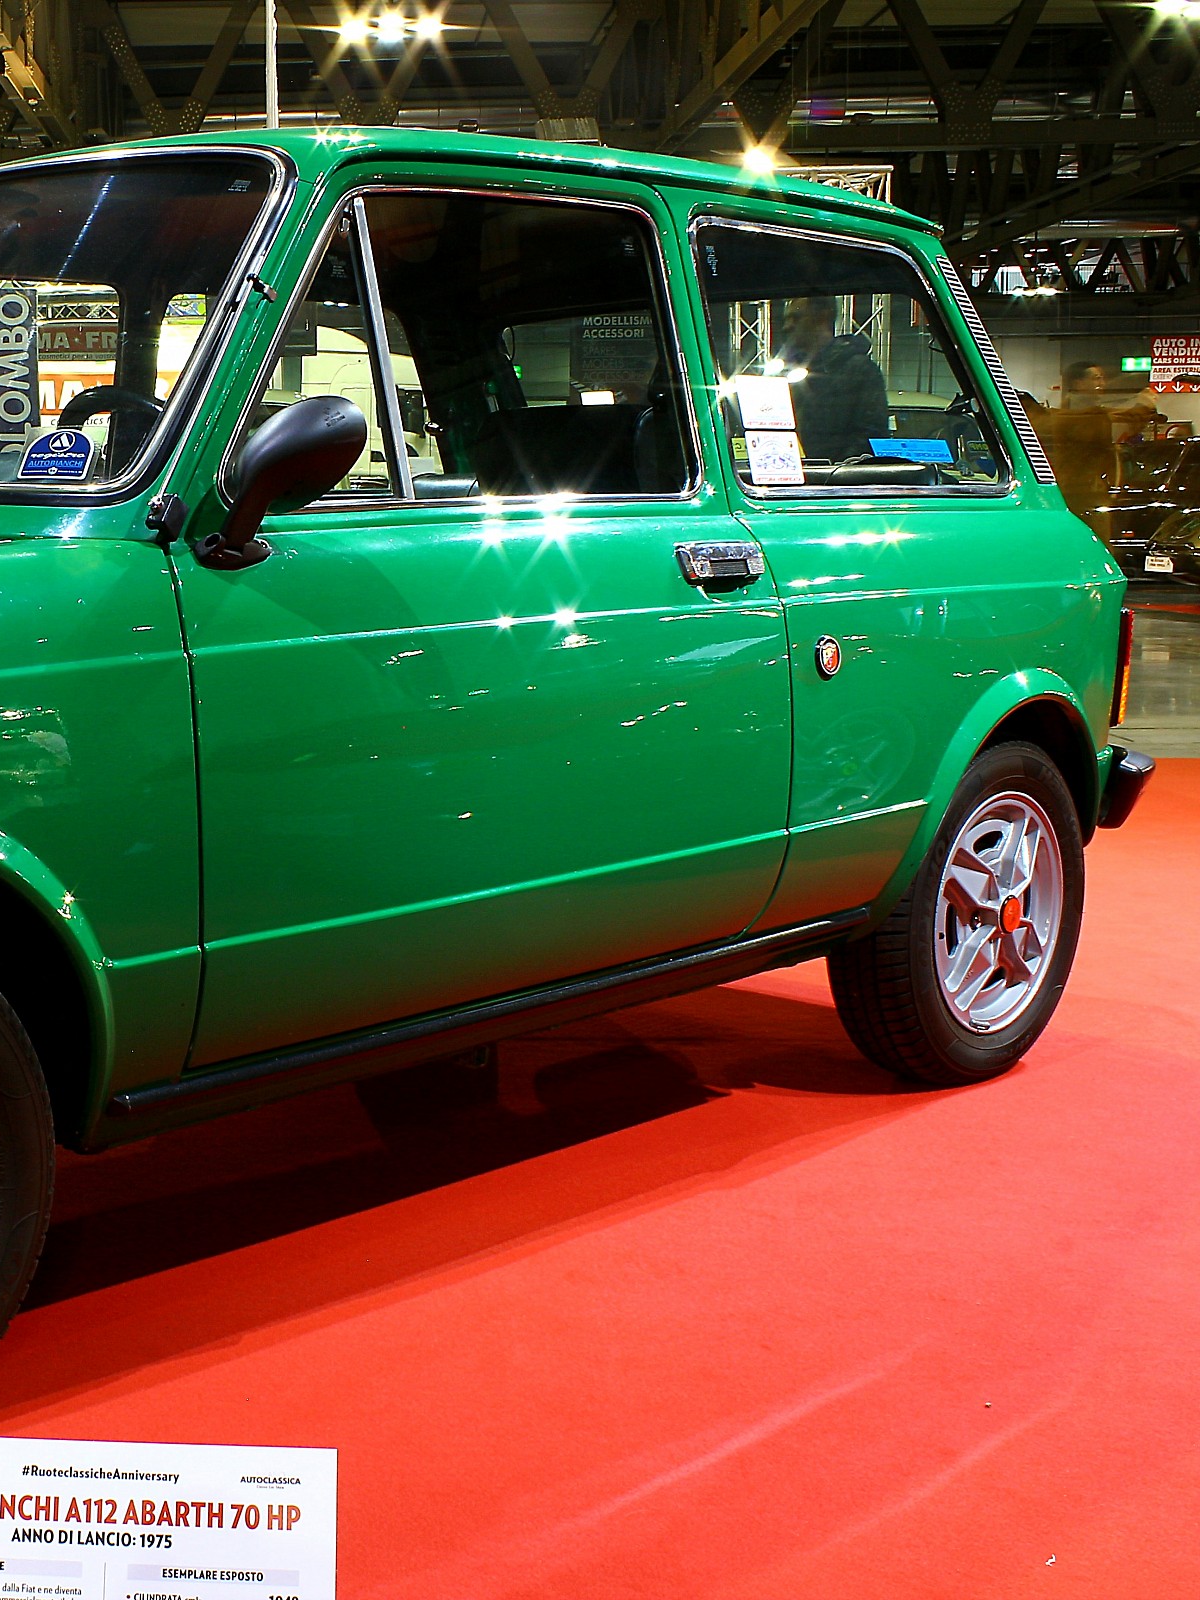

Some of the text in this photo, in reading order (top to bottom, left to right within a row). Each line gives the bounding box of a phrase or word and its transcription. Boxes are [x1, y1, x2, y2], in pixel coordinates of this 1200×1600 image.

[582, 316, 653, 326] MODELLISM
[582, 328, 645, 338] ACCESSORI
[1153, 338, 1186, 348] AUTO
[28, 460, 84, 468] AUTOBIANCHI
[22, 1465, 180, 1485] #RuoteclassicheAnniversary
[240, 1476, 301, 1485] AUTOCLASSICA
[65, 1497, 118, 1525] A112
[123, 1499, 224, 1529] ABARTH
[231, 1503, 261, 1530] 70
[267, 1504, 301, 1531] HP
[11, 1528, 173, 1549] ANNO DI LANCIO: 1975
[162, 1568, 264, 1582] ESEMPLARE ESPOSTO
[2, 1582, 20, 1593] dalla
[22, 1583, 36, 1594] Fiat
[43, 1587, 53, 1595] ne
[55, 1585, 82, 1596] diventa
